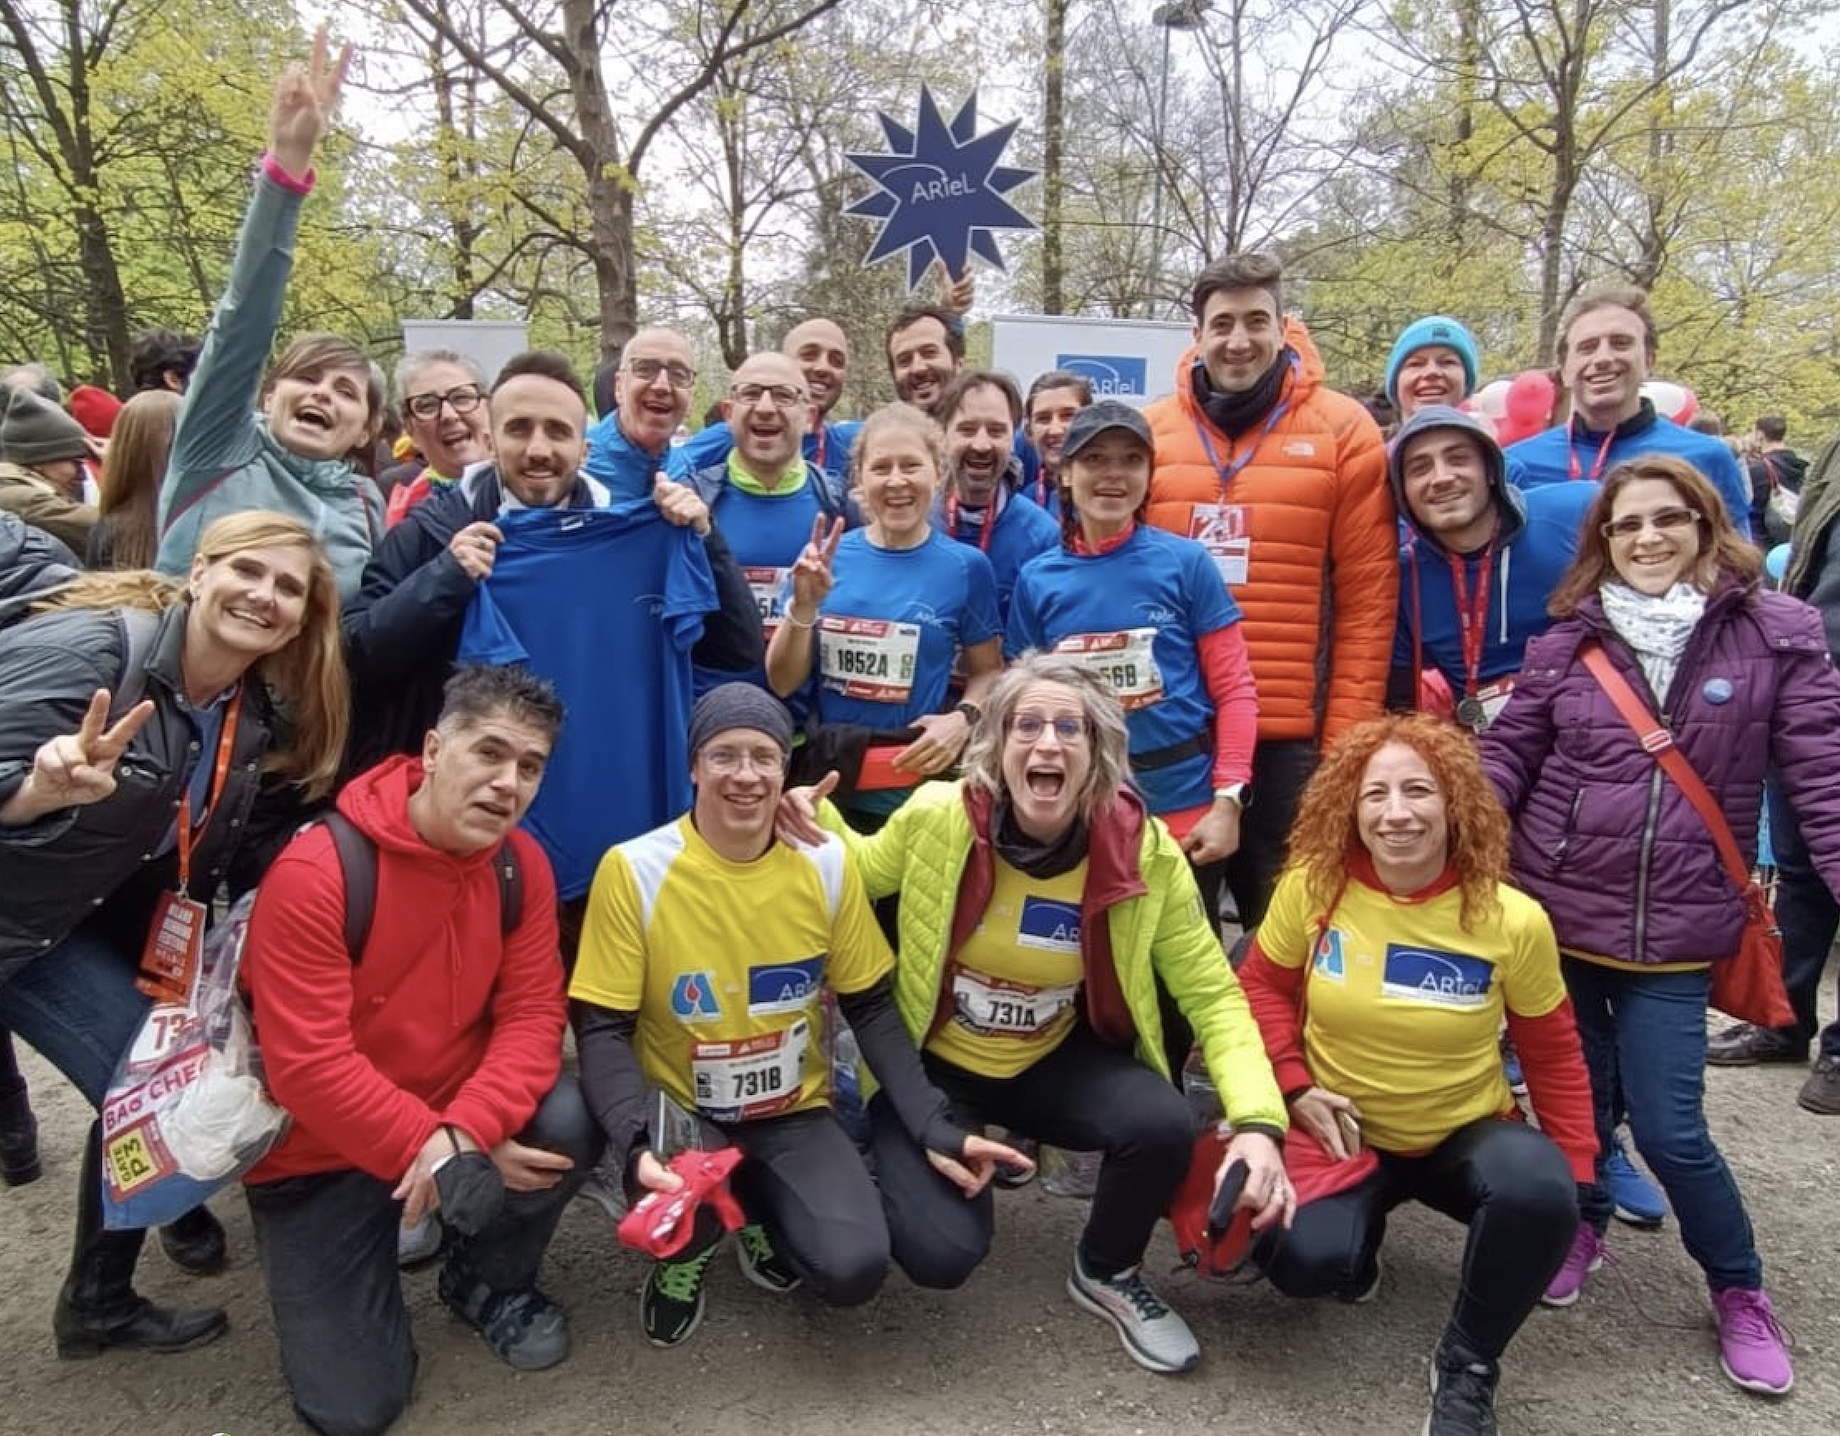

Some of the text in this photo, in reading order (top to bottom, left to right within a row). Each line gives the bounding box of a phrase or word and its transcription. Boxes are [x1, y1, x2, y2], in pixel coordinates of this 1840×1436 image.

[838, 648, 889, 677] 1852A
[1099, 663, 1137, 688] 56B
[987, 1000, 1037, 1026] 731A
[152, 1013, 204, 1051] 73
[731, 1065, 782, 1099] 731B
